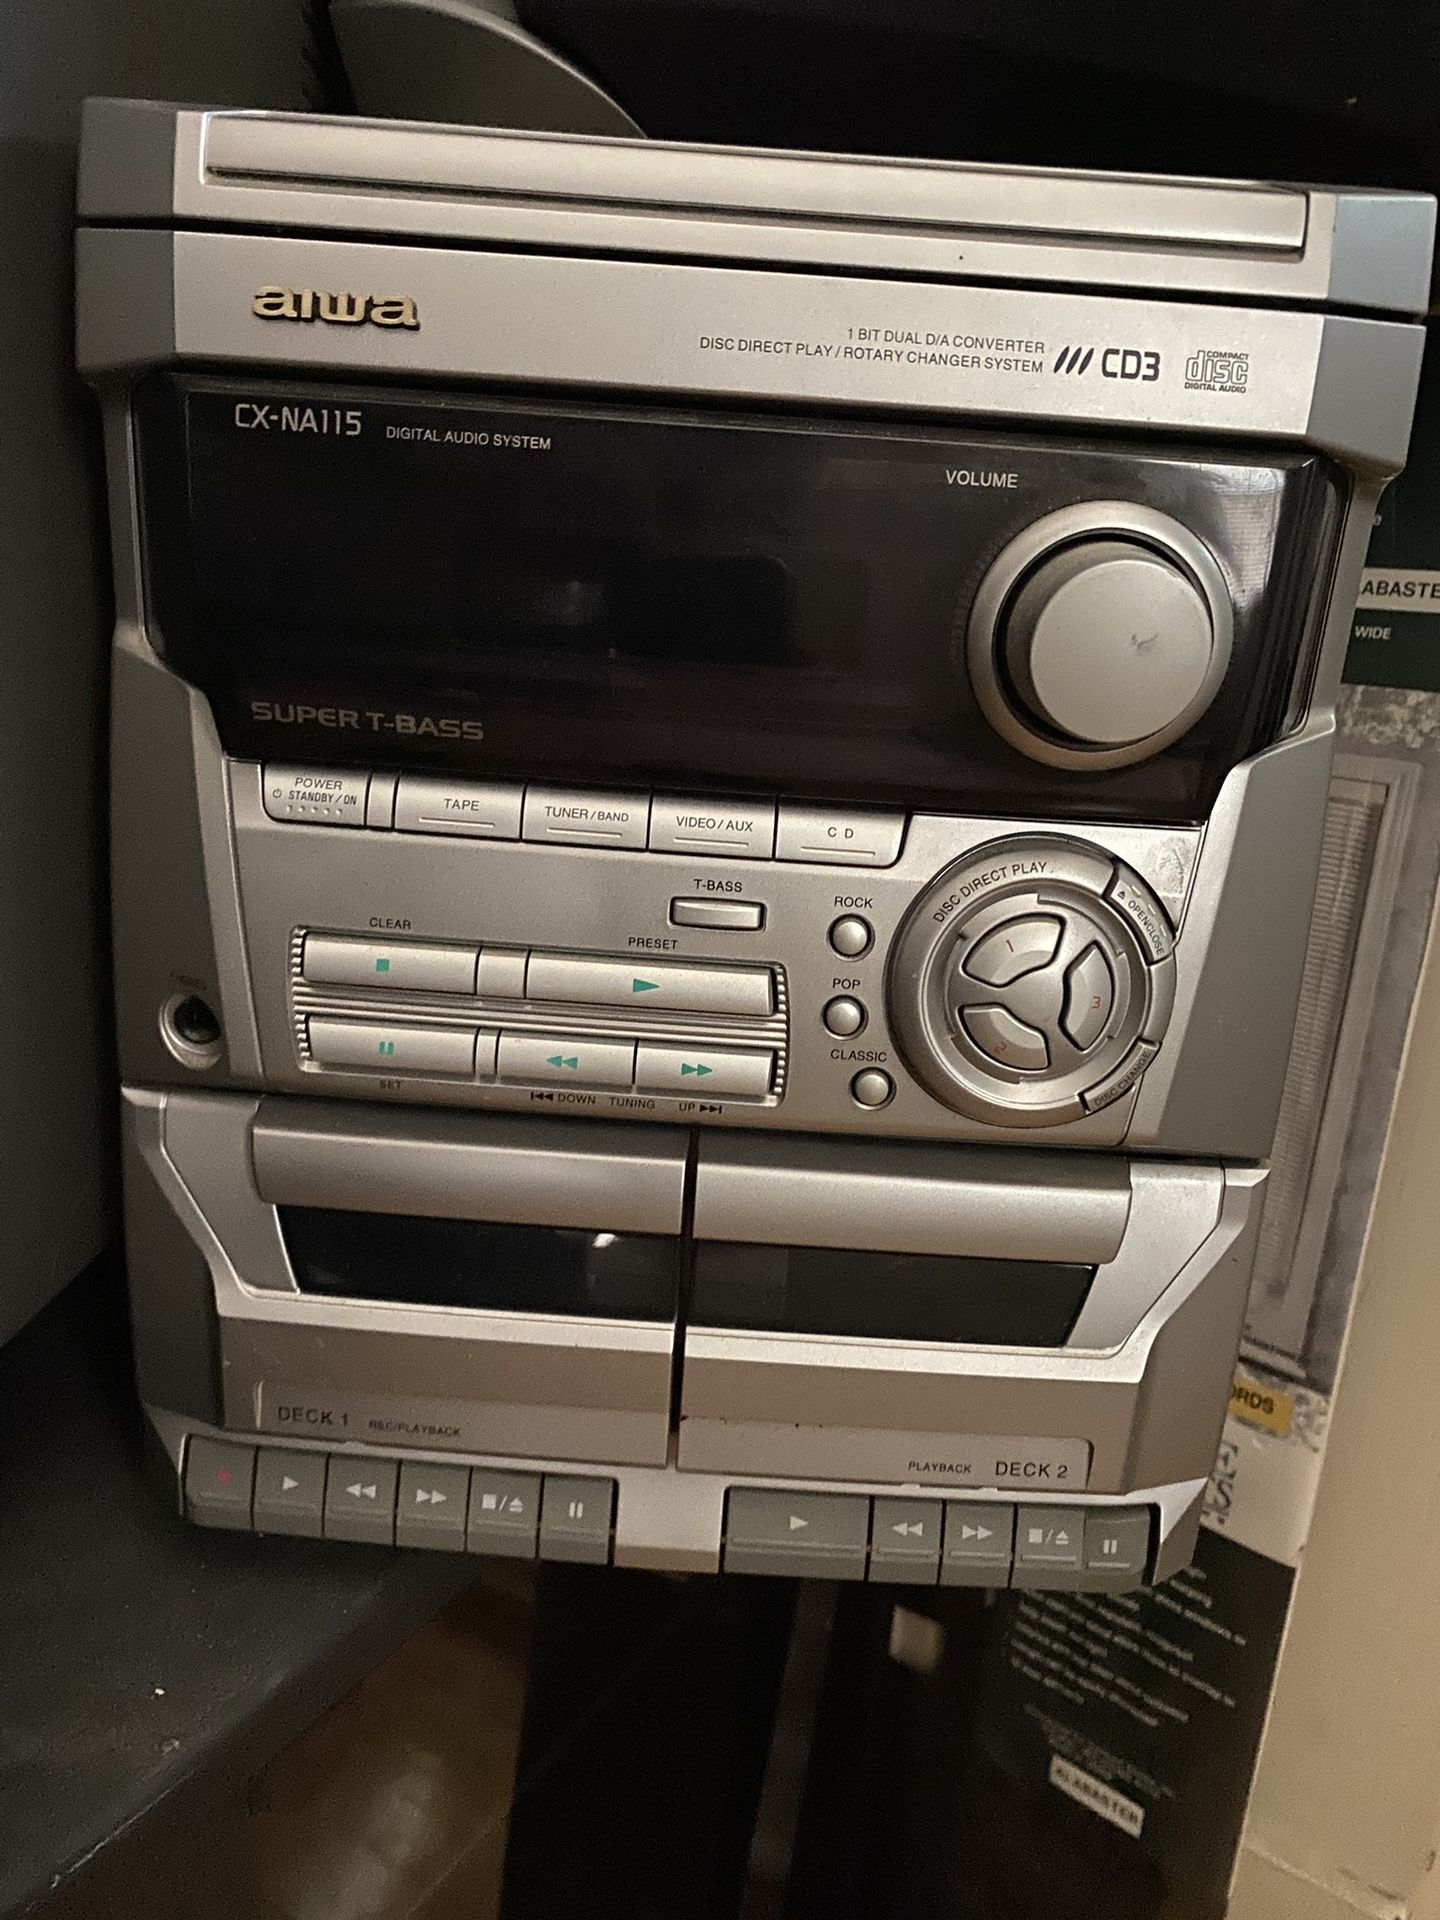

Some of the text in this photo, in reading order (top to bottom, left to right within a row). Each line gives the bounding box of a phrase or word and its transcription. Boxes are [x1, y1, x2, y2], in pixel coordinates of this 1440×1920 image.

[252, 285, 420, 330] aiwa
[847, 327, 1045, 354] 1 BIT DUAL D/A CONVERTER
[700, 337, 735, 351] DISC
[738, 339, 793, 355] DIRECT
[906, 351, 981, 369] CHANGER
[984, 356, 1044, 374] SYSTEM
[1206, 350, 1250, 361] COMPACT
[1101, 348, 1161, 382] CD3
[1184, 381, 1247, 394] DIGITAL AUDIO
[234, 403, 363, 436] CX-NA115
[386, 425, 551, 451] DIGITAL AUDIO SYSTEM
[946, 470, 1019, 489] VOLUME
[1355, 625, 1392, 640] WIDE
[251, 702, 485, 741] SUPER T-BASS
[294, 777, 343, 792] POWER
[444, 798, 480, 812] TAPE
[694, 879, 743, 893] T-BASS
[933, 861, 1048, 923] DISC DIRECT PLAY
[834, 896, 873, 909] ROCK
[369, 917, 412, 931] CLEAR
[628, 937, 678, 951] PRESET
[1005, 939, 1015, 953] 1
[832, 978, 861, 990] POP
[1091, 996, 1101, 1010] 3
[830, 1048, 888, 1063] CLASSIC
[379, 1079, 402, 1091] SET
[1093, 1050, 1151, 1108] DISC CHANGE
[557, 1092, 696, 1113] DOWN TUNING UP
[278, 1405, 348, 1428] DECK 1
[908, 1460, 972, 1475] PLAYBACK
[995, 1460, 1068, 1479] DECK 2
